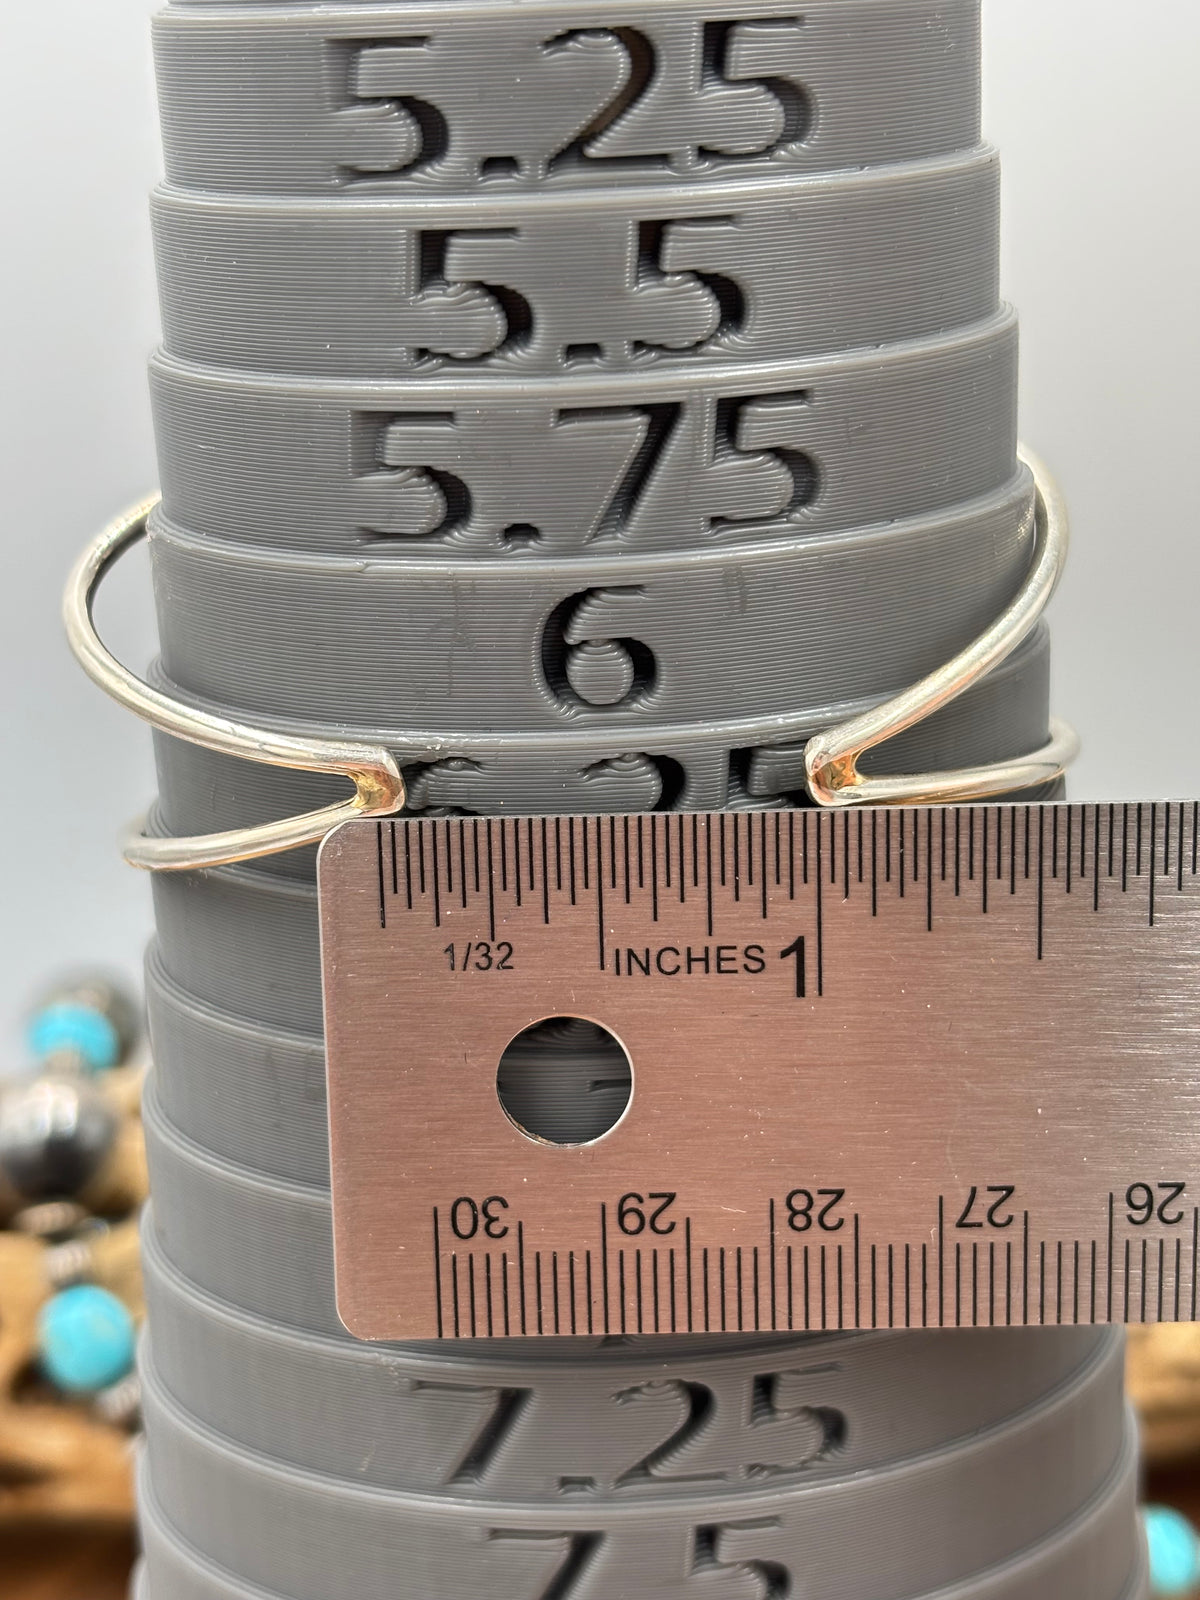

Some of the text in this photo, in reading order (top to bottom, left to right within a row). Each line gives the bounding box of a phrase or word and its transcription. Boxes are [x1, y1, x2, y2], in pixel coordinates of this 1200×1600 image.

[325, 16, 820, 188] 5.25
[402, 215, 755, 368] 5.5
[349, 389, 824, 546] 5.75
[533, 584, 665, 718] 6
[443, 940, 513, 971] 1/32
[613, 943, 766, 977] INCHES
[779, 935, 807, 998] 1
[451, 1196, 509, 1240] 30
[617, 1191, 678, 1235] 29
[786, 1188, 846, 1231] 28
[955, 1184, 1016, 1229] 27
[1125, 1181, 1185, 1225] 26
[403, 1360, 850, 1495] 7.25
